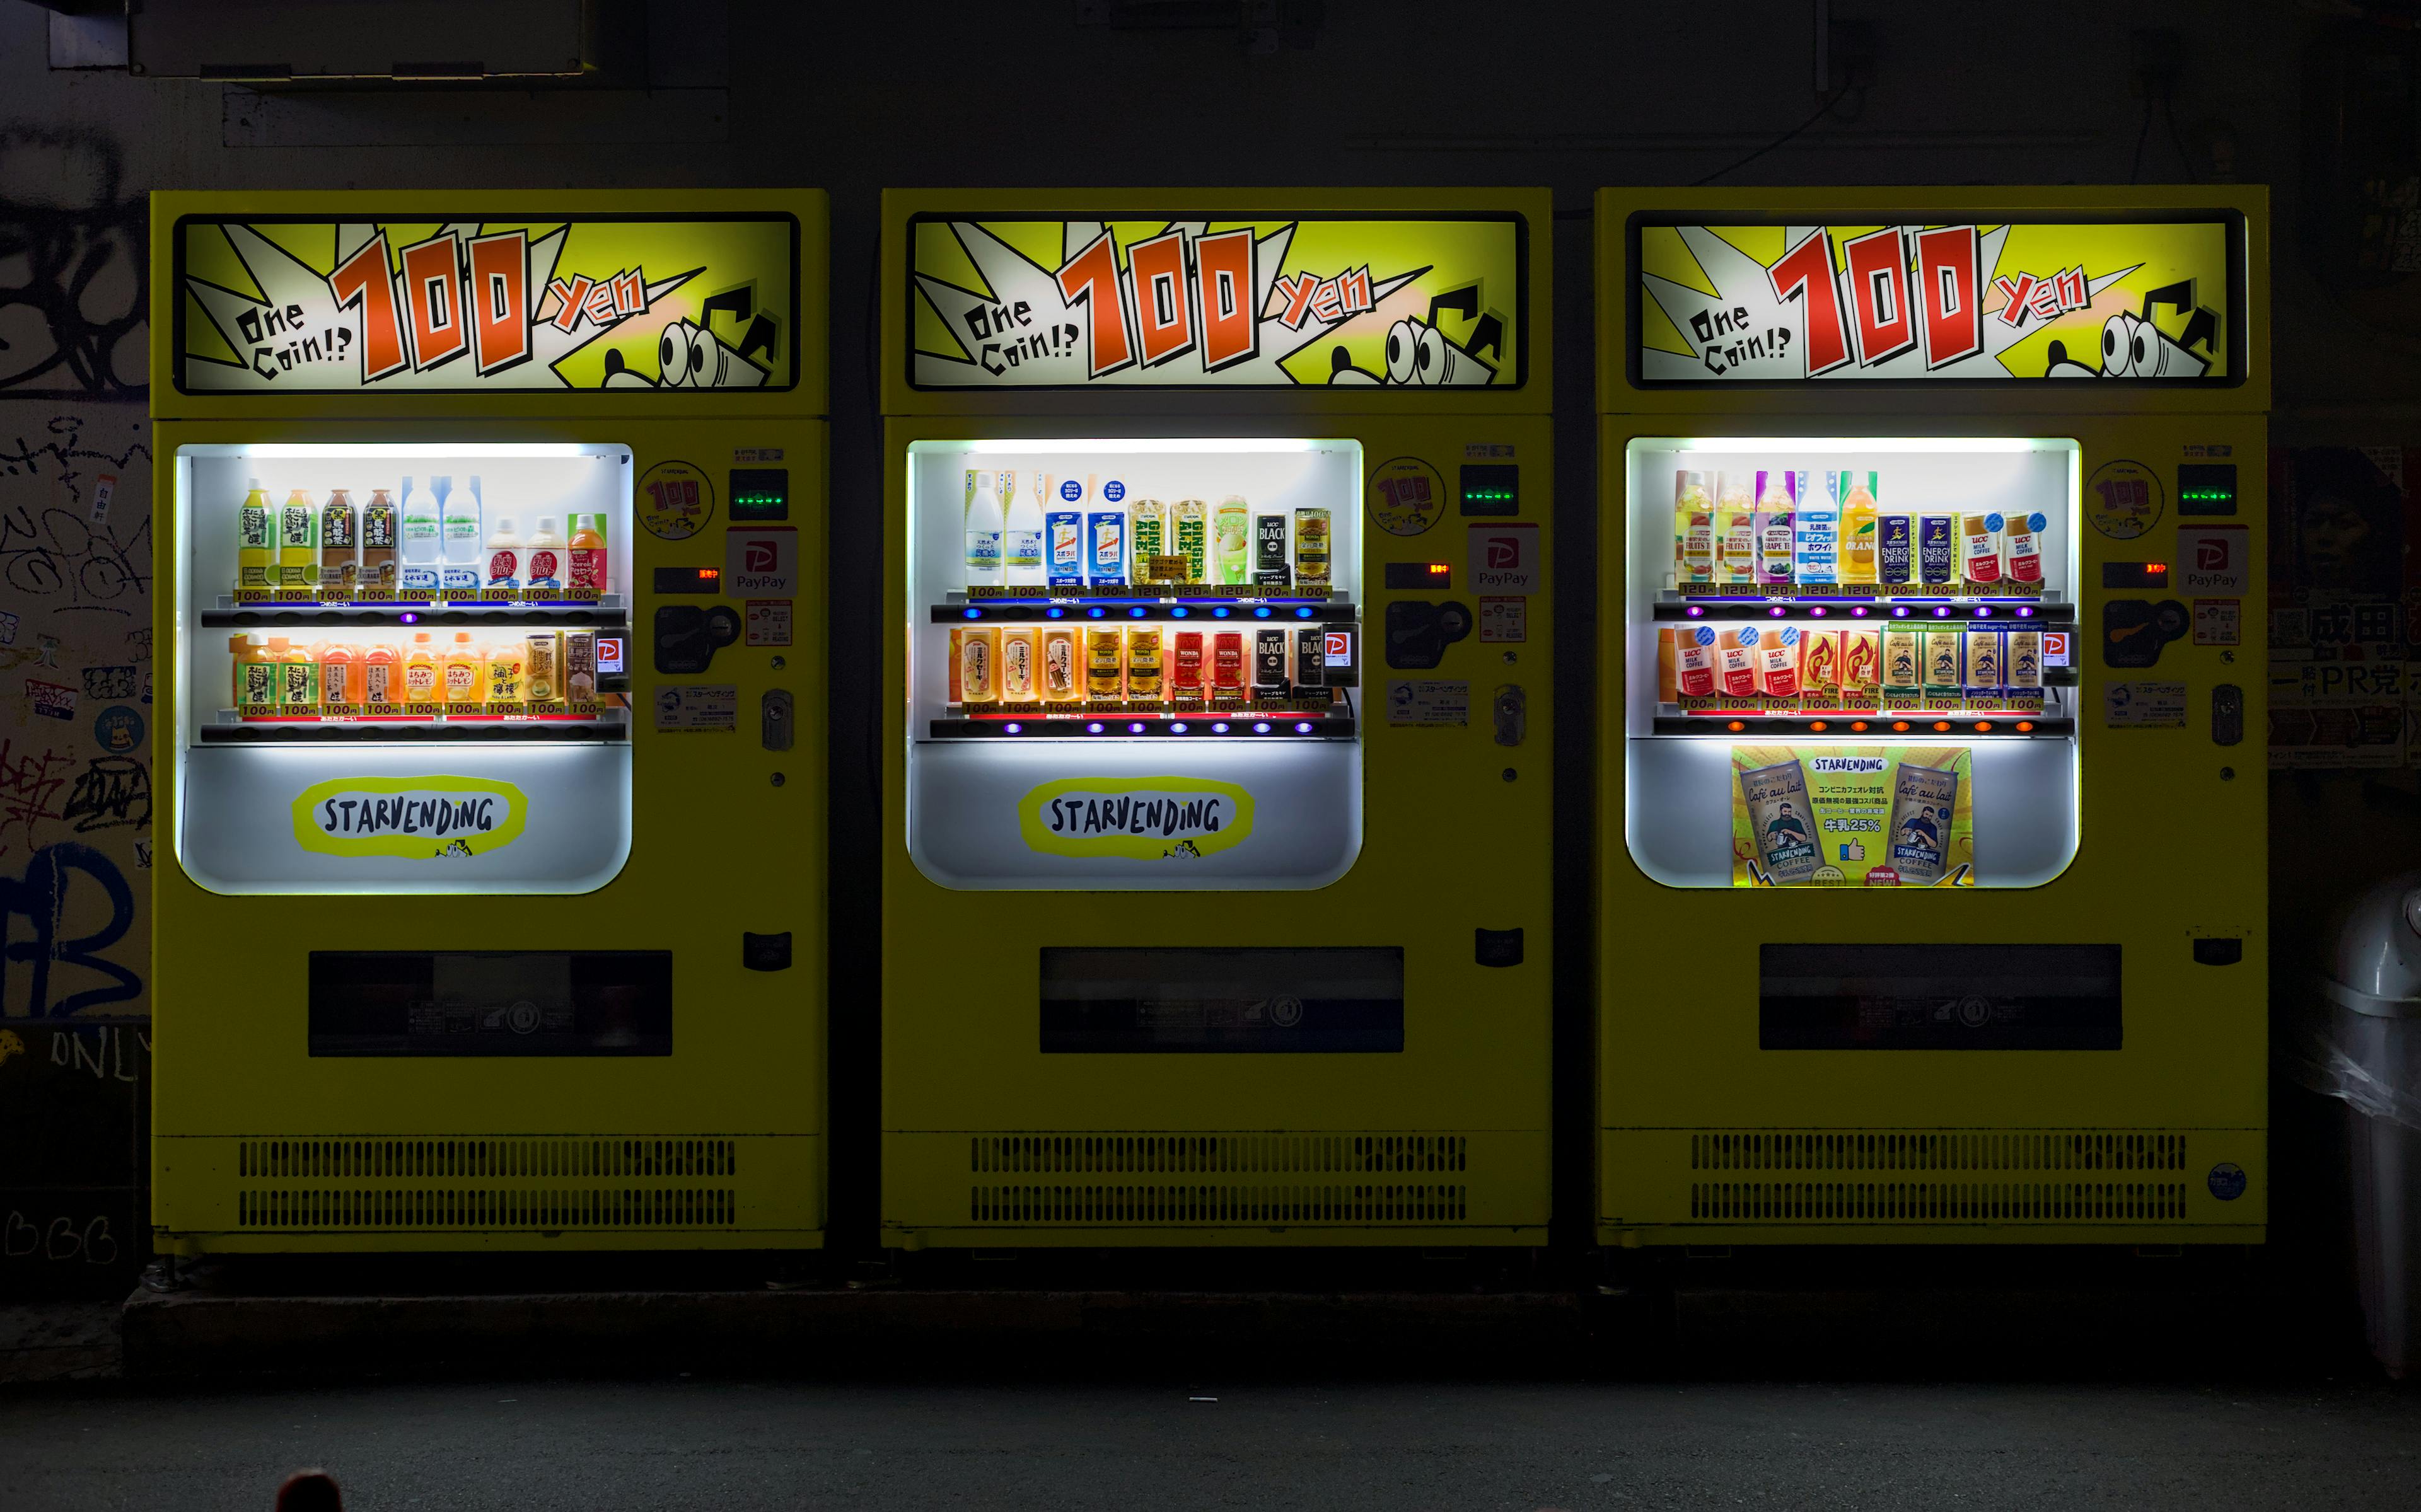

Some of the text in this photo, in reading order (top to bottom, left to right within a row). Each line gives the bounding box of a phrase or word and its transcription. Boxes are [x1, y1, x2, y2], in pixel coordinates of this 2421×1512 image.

[328, 227, 651, 385] 100 yen
[1055, 225, 1378, 379] 100 yen
[1767, 225, 2090, 379] 100 yen
[236, 304, 305, 345] One
[964, 301, 1032, 342] One
[1689, 306, 1750, 344] One
[646, 479, 699, 511] 100
[1377, 475, 1431, 508] 100
[2096, 479, 2149, 510] 100
[1221, 516, 1246, 526] メロン
[1135, 521, 1148, 550] ALE
[1260, 528, 1285, 540] BLACK
[1179, 521, 1203, 578] GINGER ALE
[1923, 547, 1950, 555] ENERGY
[738, 577, 786, 589] PayPay
[1479, 572, 1528, 586] PayPay
[2188, 574, 2238, 587] PayPay
[972, 588, 1002, 596] 100円
[1054, 588, 1084, 596] 100円
[1095, 587, 1125, 596] 100円
[1178, 587, 1208, 596] 120円
[1220, 587, 1250, 596] 120円
[1299, 587, 1330, 596] 100円
[1683, 585, 1713, 594] 120円
[1765, 586, 1795, 594] 120円
[1806, 586, 1835, 594] 120円
[1884, 586, 1914, 595] 100円
[1926, 586, 1956, 595] 100円
[2008, 586, 2038, 595] 100円
[237, 592, 268, 600] 100円
[320, 592, 351, 600] 100円
[362, 592, 392, 600] 100円
[1259, 642, 1284, 654] BLACK
[494, 668, 514, 679] 柚子
[573, 704, 603, 713] 100円
[966, 703, 996, 712] 100円
[1048, 703, 1079, 712] 100円
[1089, 703, 1120, 712] 100円
[1173, 702, 1202, 711] 100円
[1212, 701, 1243, 710] 100円
[1296, 701, 1326, 710] 100円
[1806, 700, 1837, 708] 100円
[1888, 700, 1918, 708] 100円
[1929, 700, 1958, 708] 100円
[2011, 700, 2040, 708] 100円
[243, 706, 274, 715] 100円
[327, 706, 357, 714] 100円
[368, 706, 398, 714] 100円
[449, 705, 479, 713] 100円
[490, 705, 520, 713] 100円
[1816, 758, 1883, 771] STARVENDING
[1750, 780, 1802, 802] Café au lait
[1899, 781, 1952, 802] Café au lait
[1824, 819, 1881, 832] 牛乳25%
[1771, 846, 1811, 862] STARVENDING
[1898, 846, 1936, 860] STARVENDING
[1777, 857, 1810, 869] COFFEE
[1900, 858, 1932, 869] COFFEE
[50, 1026, 151, 1082] ONL
